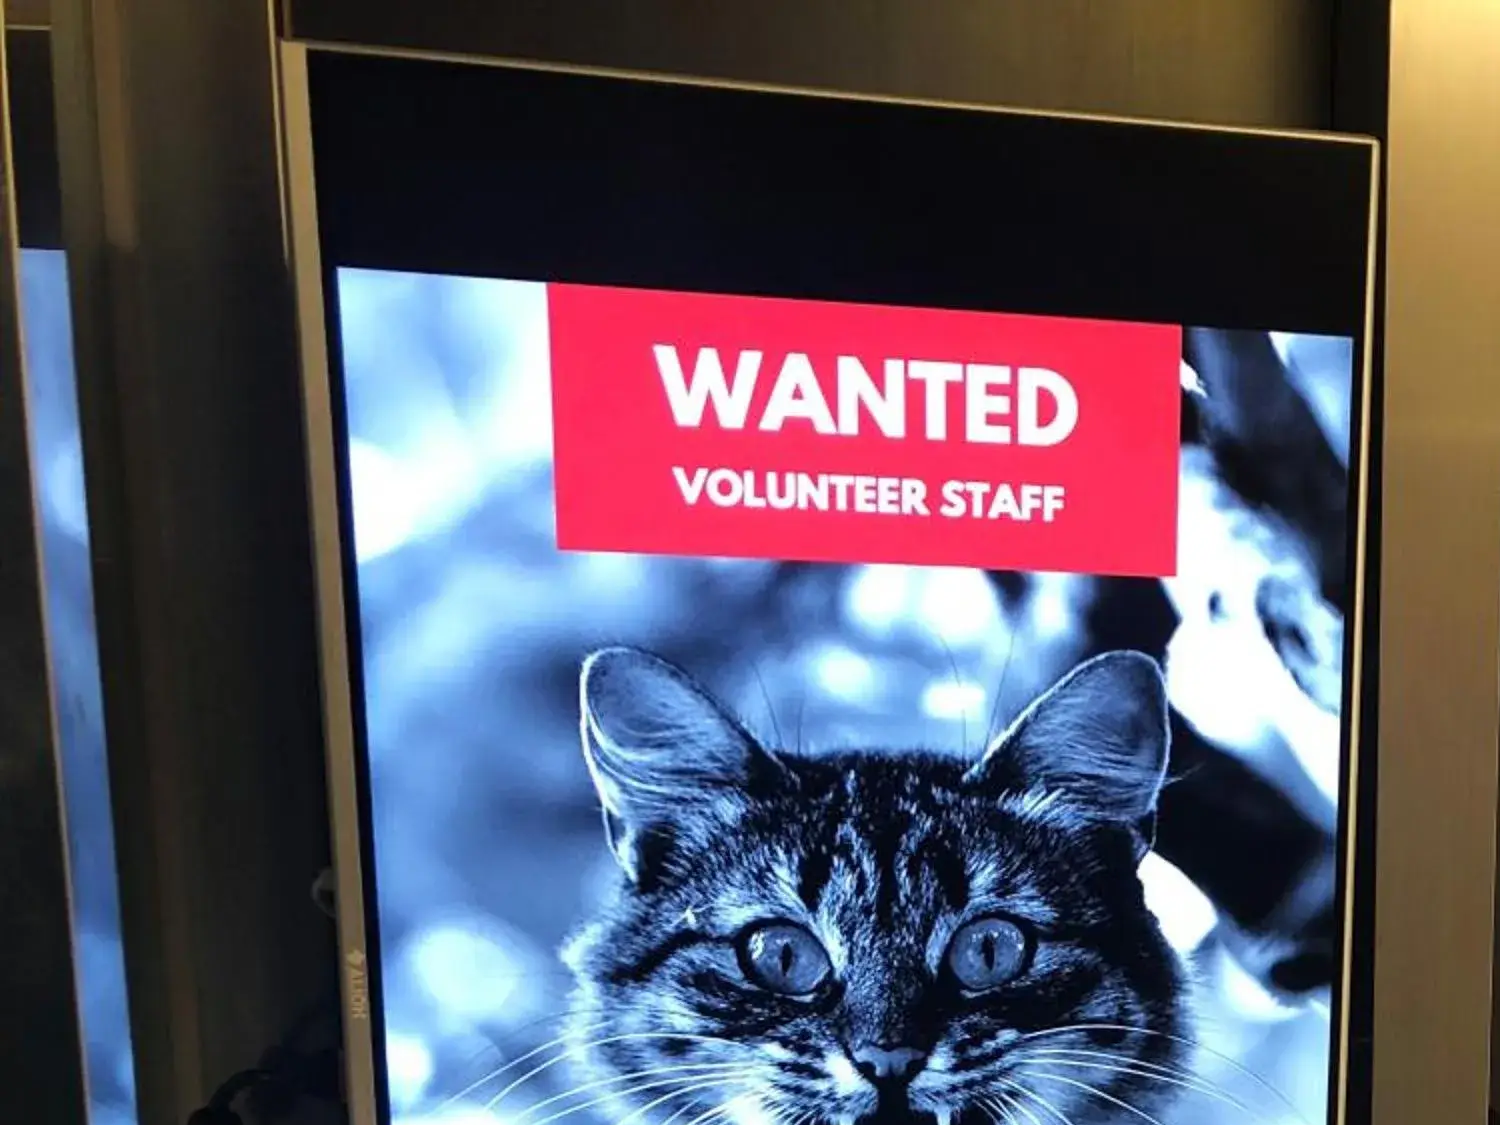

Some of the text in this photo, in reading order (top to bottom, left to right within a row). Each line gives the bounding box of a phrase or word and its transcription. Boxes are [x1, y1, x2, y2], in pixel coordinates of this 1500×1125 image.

[652, 344, 1079, 447] WANTED
[671, 465, 1065, 522] VOLUNTEER STAFF
